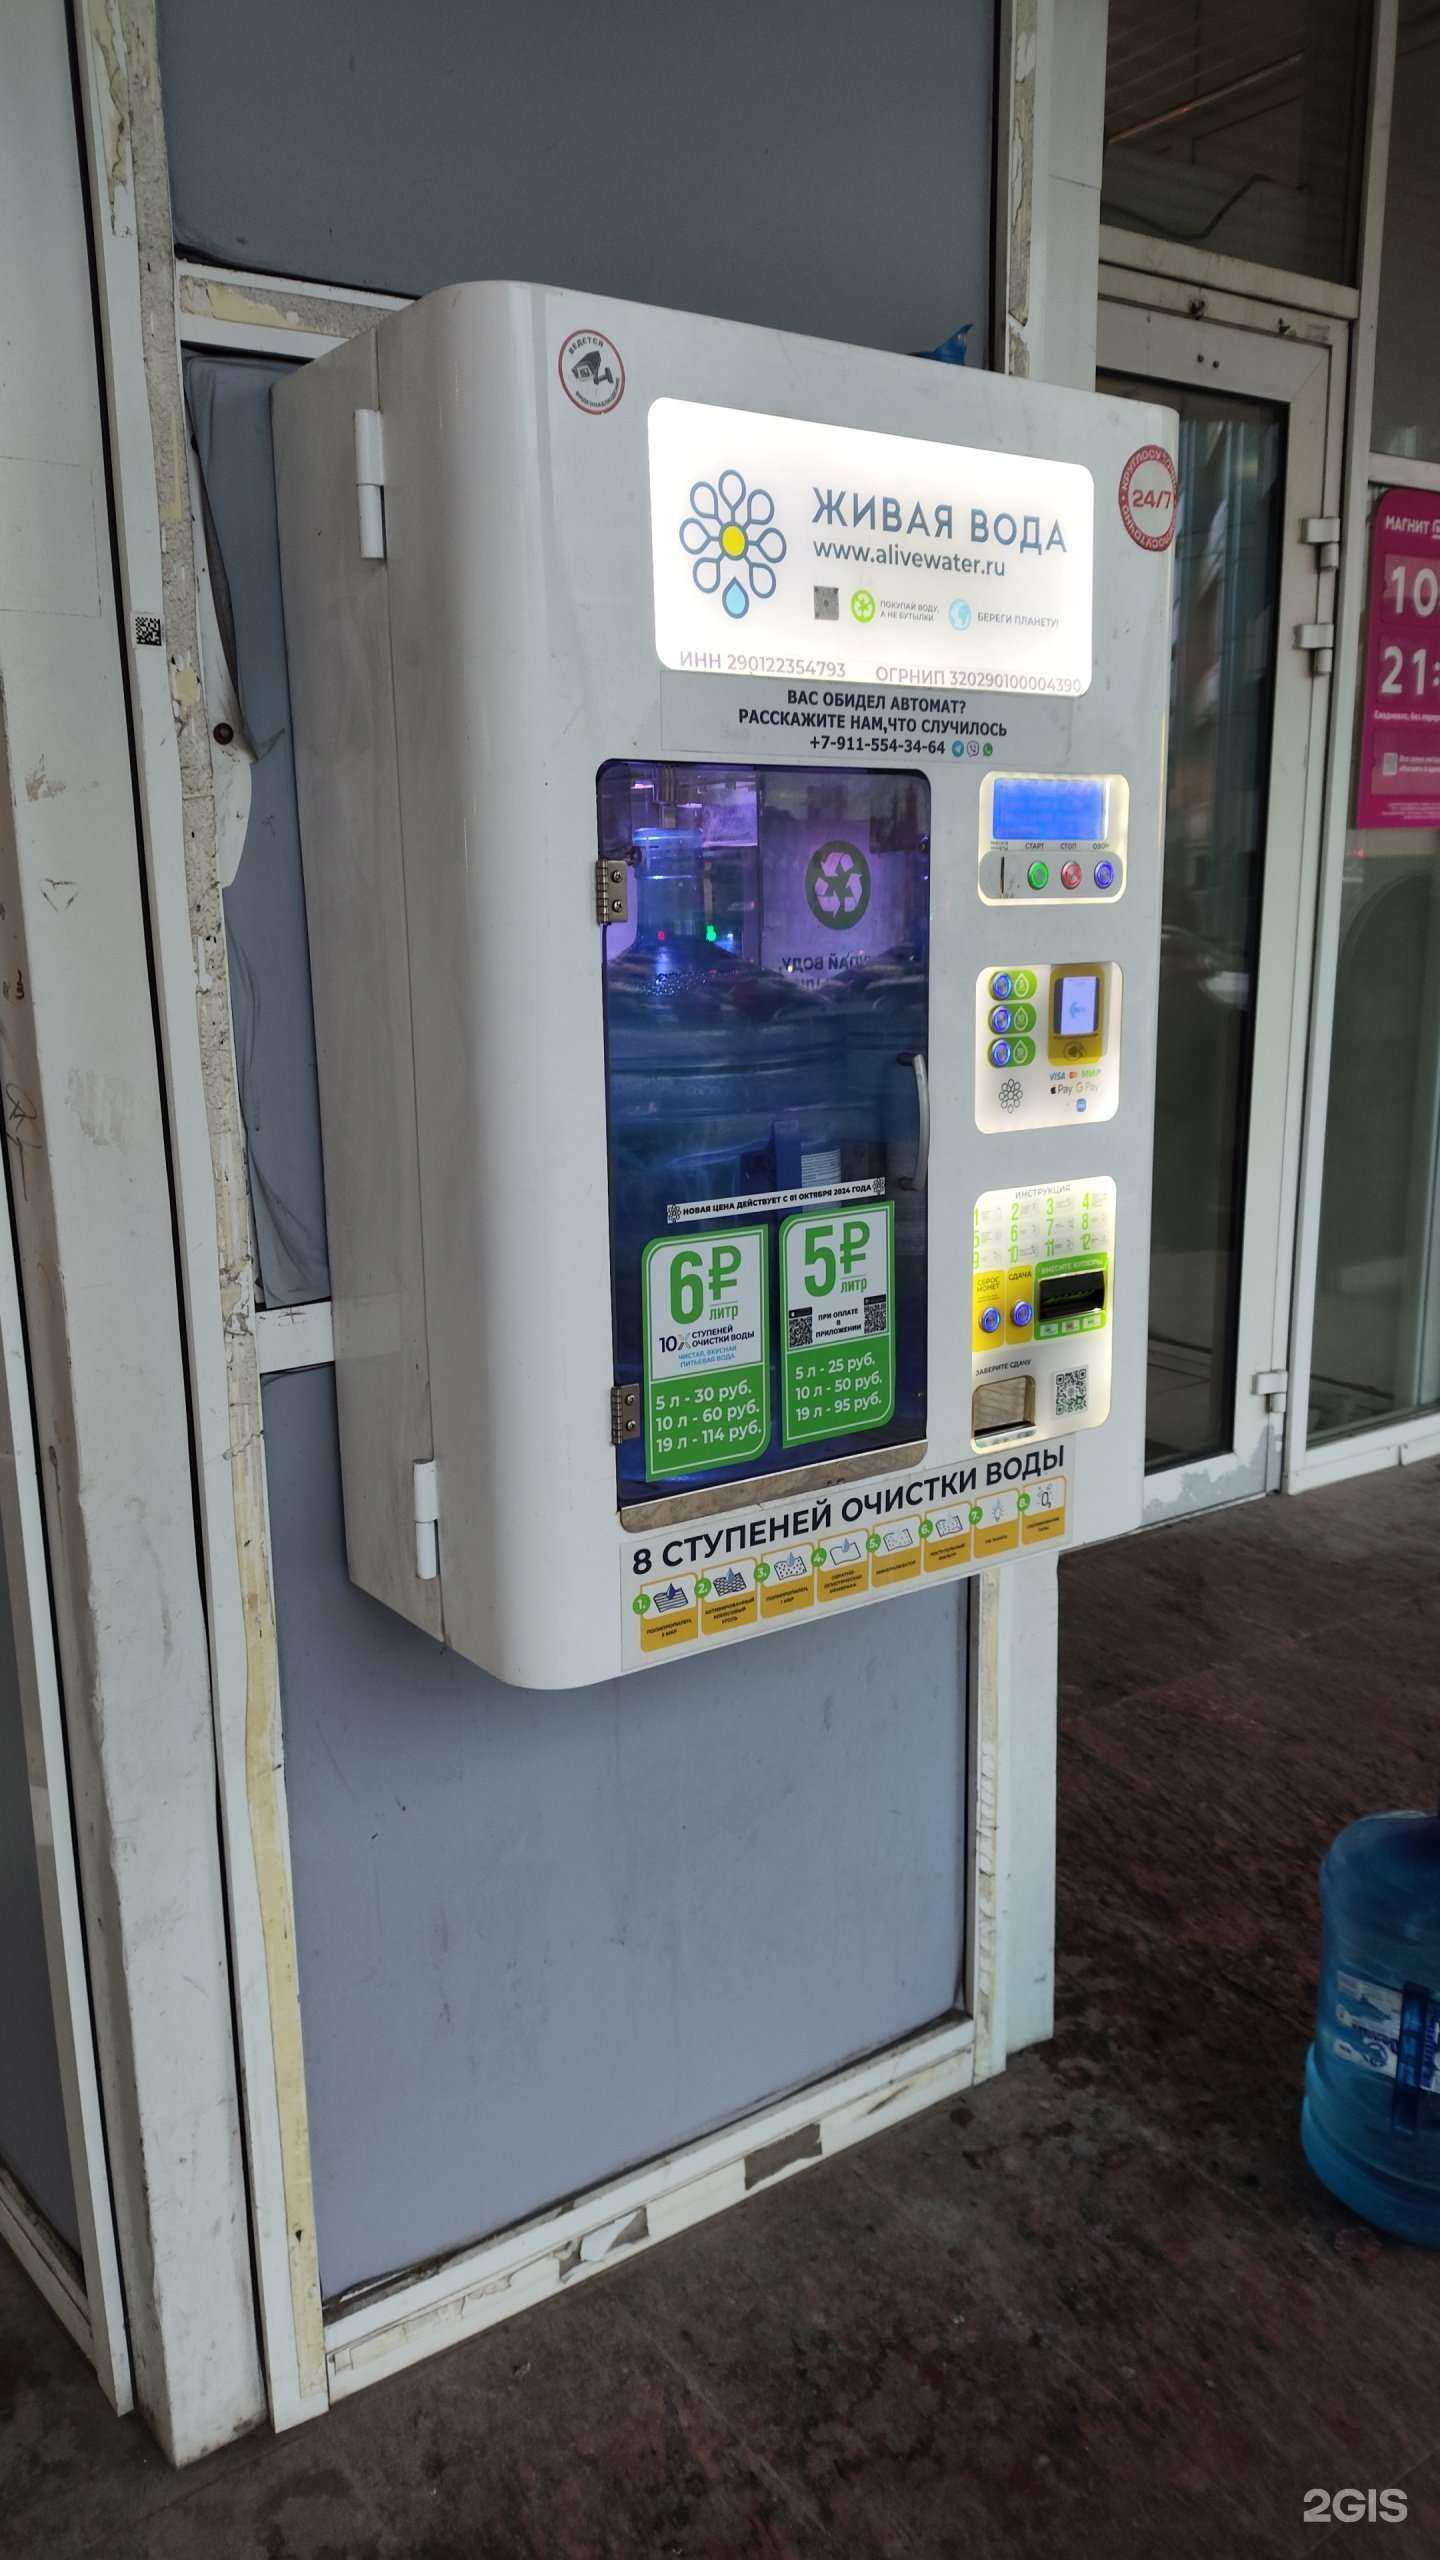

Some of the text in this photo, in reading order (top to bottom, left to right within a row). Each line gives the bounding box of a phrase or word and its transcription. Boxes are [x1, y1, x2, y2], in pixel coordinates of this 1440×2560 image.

[1132, 489, 1172, 510] 24/7
[811, 487, 1068, 556] ЖИВАЯ ВОДА
[1386, 515, 1431, 535] МАГНИТ
[813, 540, 1005, 577] www.alivewater.ru
[880, 599, 917, 612] ПОКУПАЙ
[887, 611, 898, 620] НЕ
[977, 611, 1013, 624] БЕРЕГИ
[679, 651, 847, 678] ИНН 290122354793
[875, 667, 1082, 692] ОГРНИП 320290100004390
[786, 689, 967, 714] ВАС ОБИДЕЛ АВТОМАТ?
[738, 708, 846, 729] РАССКАЖИТЕ
[921, 718, 1008, 737] СЛУЧИЛОСЬ
[809, 735, 946, 755] +7-911-554-34-64
[1025, 842, 1045, 850] СТАРТ
[1060, 842, 1077, 850] СТОП
[1049, 1071, 1066, 1081] VISA
[1057, 1083, 1073, 1096] Pay
[682, 1205, 711, 1215] НОВАЯ
[712, 1202, 735, 1213] ЦЕНА
[736, 1196, 782, 1211] ДЕЙСТВУЕТ
[798, 1189, 832, 1201] ОКТЯБРЯ
[833, 1187, 851, 1196] 2024
[851, 1184, 872, 1194] ГОДА
[1015, 1184, 1071, 1199] ИНСТРУКЦИЯ
[1010, 1202, 1019, 1221] 2
[1045, 1198, 1054, 1216] 3
[1082, 1192, 1090, 1210] 4
[1010, 1224, 1018, 1242] 6
[1045, 1218, 1054, 1237] 7
[1082, 1213, 1089, 1230] 8
[1008, 1246, 1018, 1264] 10
[1045, 1239, 1055, 1257] 11
[1080, 1233, 1091, 1251] 12
[1008, 1271, 1032, 1281] СДАЧА
[818, 1308, 859, 1321] ПРИ ОПЛАТЕ
[691, 1324, 733, 1339] СТУПЕНЕЙ
[691, 1331, 755, 1348] ОЧИСТКИ ВОДЫ
[815, 1324, 862, 1338] ПРИЛОЖЕНИИ
[795, 1367, 804, 1380] 5
[807, 1365, 816, 1377] л
[828, 1359, 844, 1374] 25
[847, 1351, 876, 1371] руб.
[976, 1359, 1032, 1376] ЗАБЕРИТЕ СДАЧУ
[656, 1395, 665, 1410] 5
[669, 1392, 680, 1403] л
[694, 1387, 714, 1404] 30
[719, 1379, 752, 1402] руб.
[795, 1386, 810, 1400] 10
[813, 1385, 823, 1397] л
[834, 1379, 851, 1393] 50
[854, 1371, 883, 1390] руб.
[656, 1416, 673, 1432] 10
[677, 1415, 688, 1427] л
[702, 1407, 722, 1423] 60
[727, 1400, 760, 1421] руб.
[796, 1406, 810, 1421] 19
[813, 1406, 823, 1418] л
[834, 1399, 851, 1413] 95
[854, 1392, 882, 1411] руб.
[656, 1437, 673, 1453] 19
[677, 1437, 688, 1449] л
[702, 1428, 725, 1445] 114
[729, 1419, 762, 1441] руб.
[633, 1444, 1065, 1575] 8 СТУПЕНЕЙ ОЧИСТКИ ВОДЫ
[921, 1523, 930, 1534] 6.
[699, 1583, 708, 1594] 2.
[637, 1599, 646, 1610] 1.
